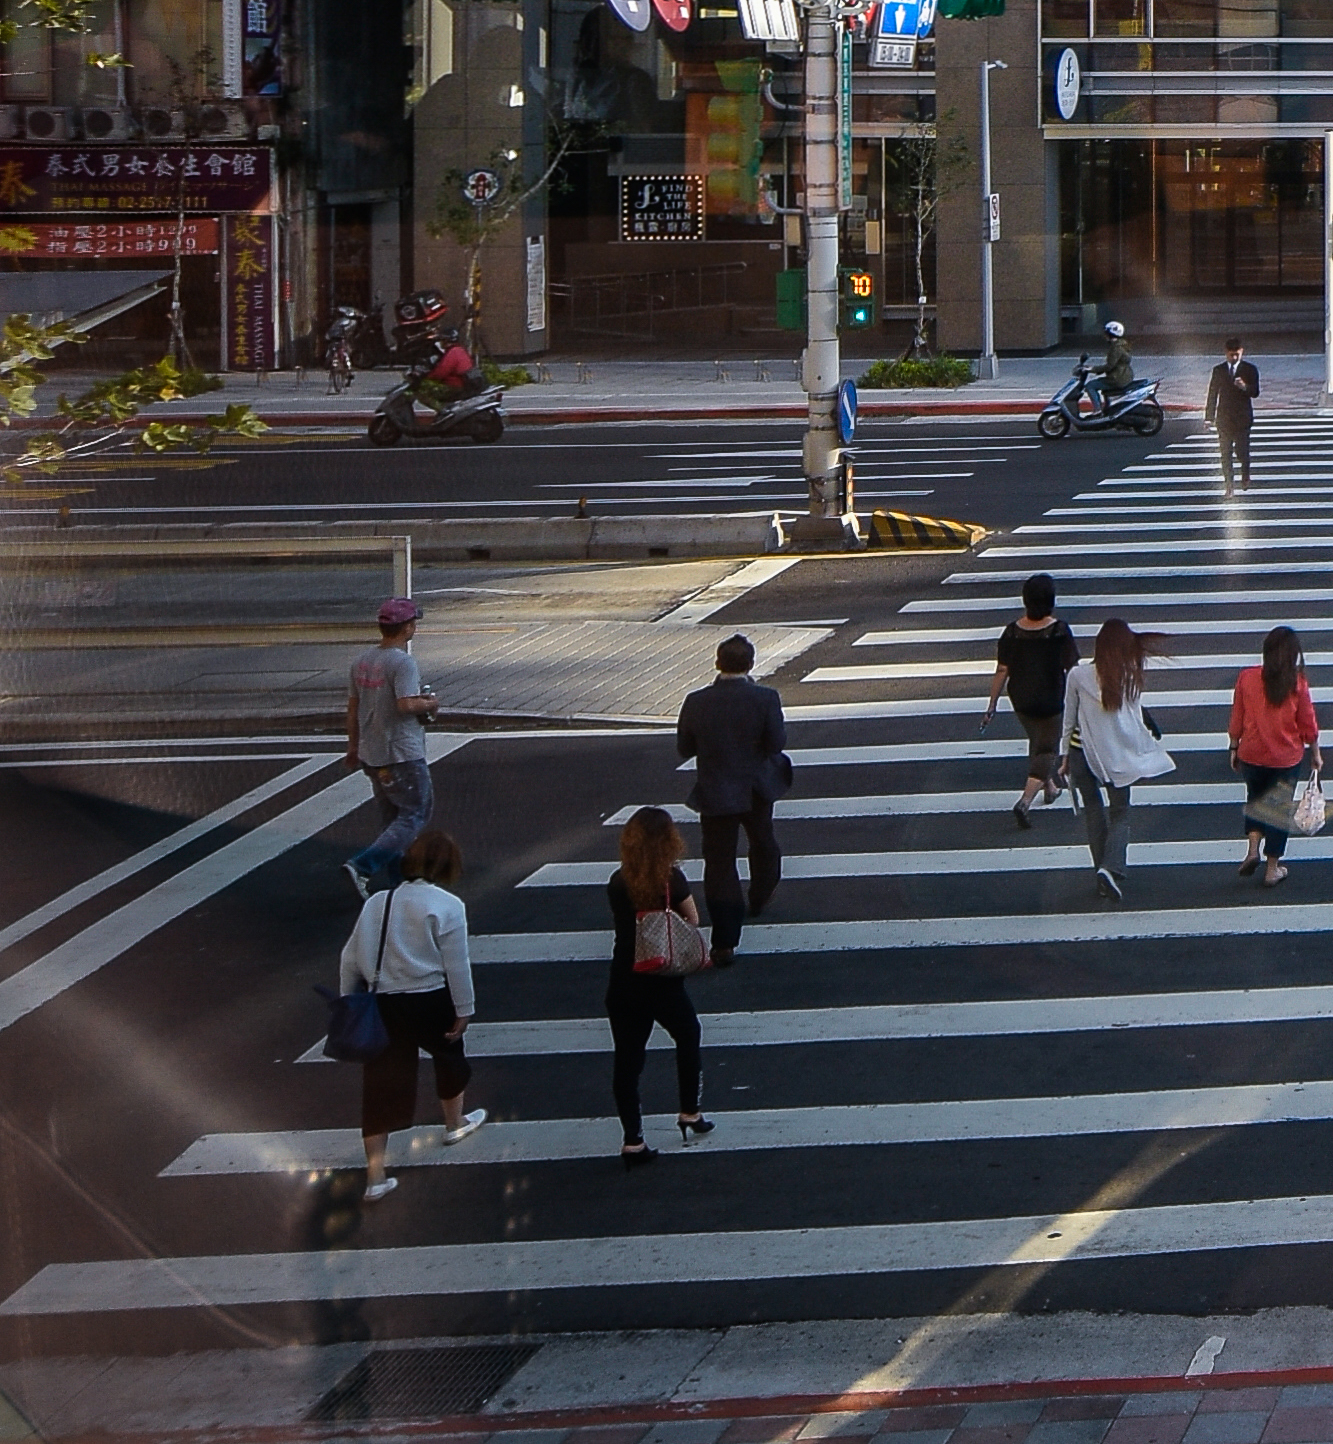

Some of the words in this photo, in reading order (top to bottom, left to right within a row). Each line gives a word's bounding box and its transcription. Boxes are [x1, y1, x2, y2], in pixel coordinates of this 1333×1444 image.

[662, 184, 694, 192] FIND
[663, 201, 692, 210] LIFE
[850, 275, 871, 296] 70
